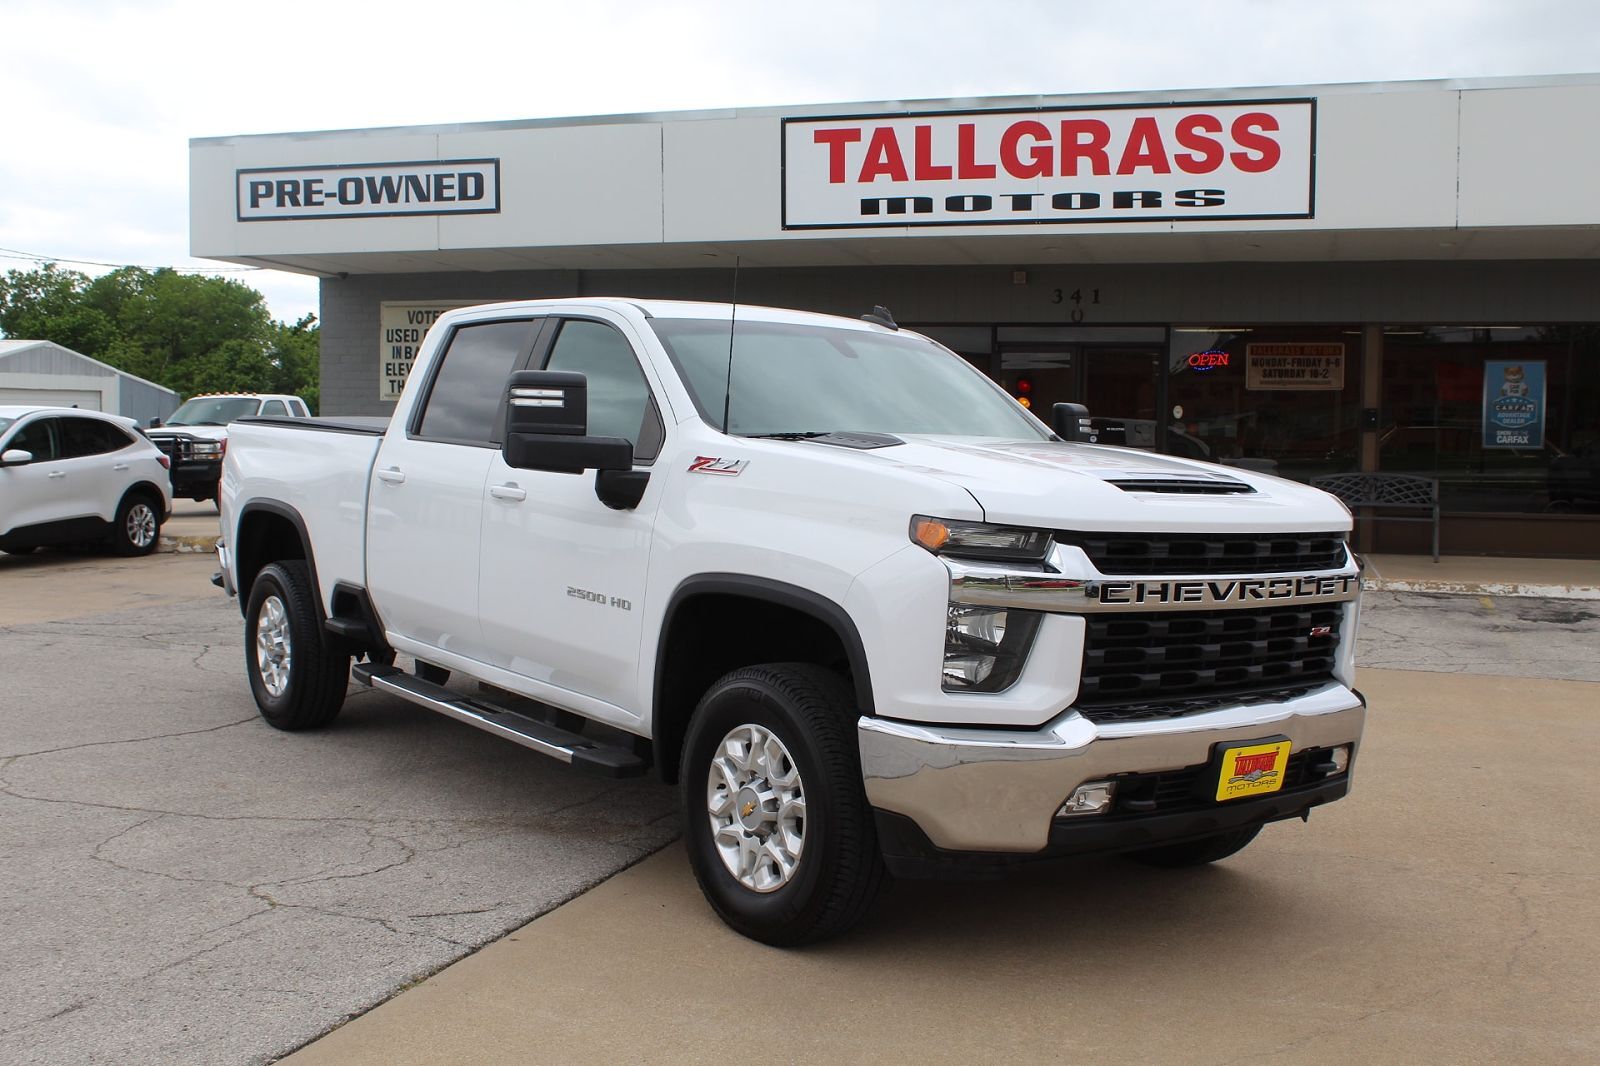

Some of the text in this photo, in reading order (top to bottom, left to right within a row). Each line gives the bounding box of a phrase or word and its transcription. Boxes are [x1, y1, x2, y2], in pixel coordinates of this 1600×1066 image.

[813, 112, 1281, 184] TALLGRASS
[250, 172, 484, 208] PRE-OWNED
[407, 310, 447, 324] VOTE
[386, 329, 419, 343] USED
[392, 346, 402, 359] IN
[1188, 353, 1229, 366] OPEN
[385, 362, 413, 376] ELEV
[1262, 368, 1306, 378] SATURDAY
[1496, 436, 1528, 444] CARFAX
[1099, 577, 1356, 605] CHEVROLET
[567, 586, 631, 611] 2500 HD
